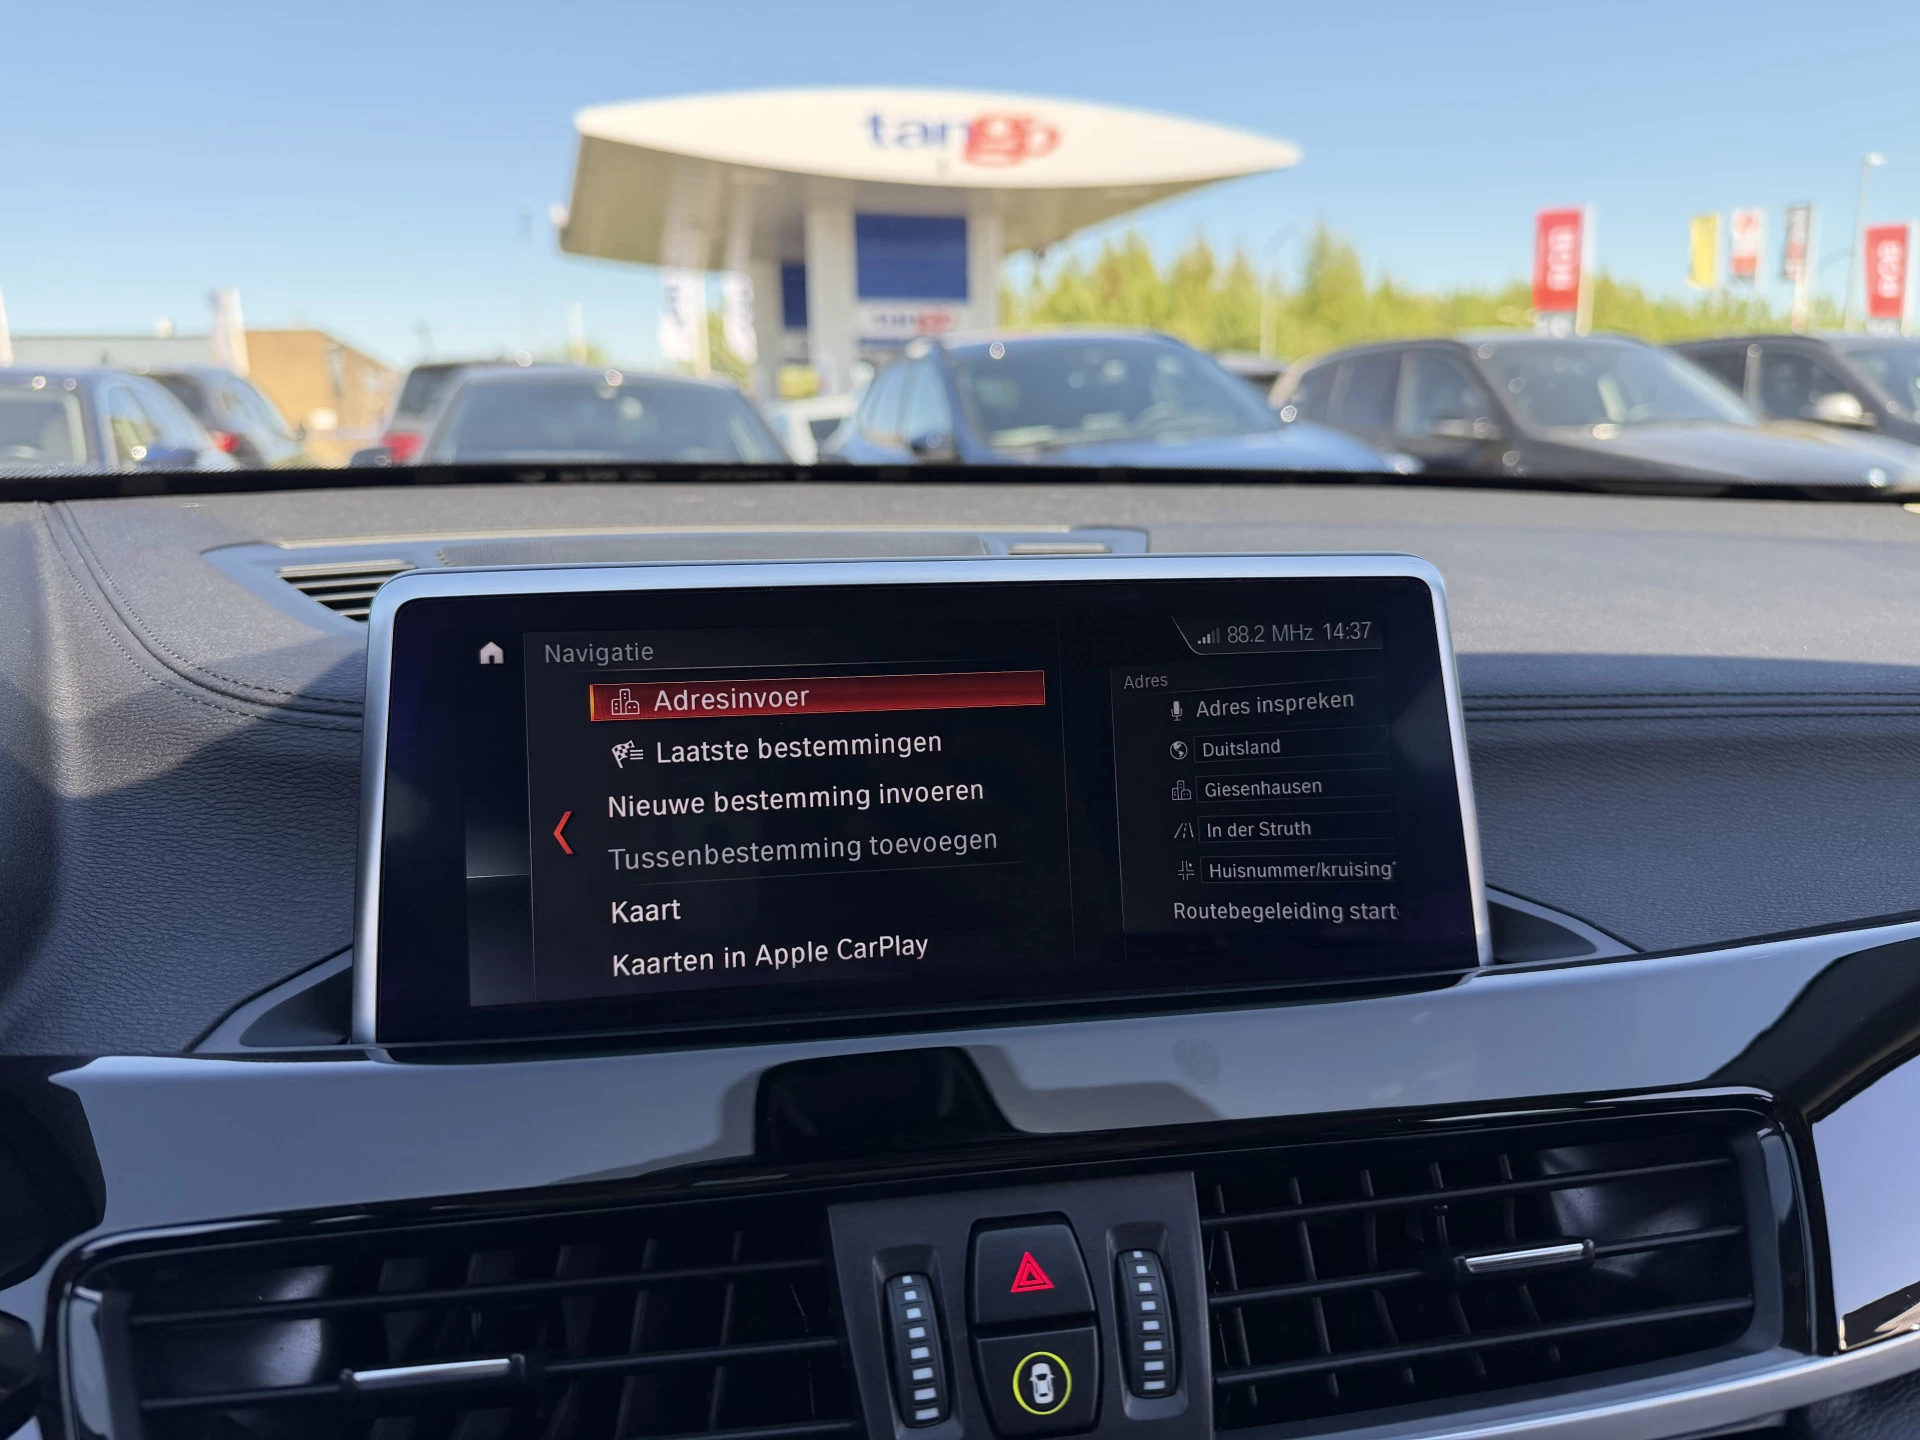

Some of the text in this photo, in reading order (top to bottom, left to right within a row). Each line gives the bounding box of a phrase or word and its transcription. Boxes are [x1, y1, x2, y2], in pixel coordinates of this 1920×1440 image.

[1227, 621, 1371, 643] 88.2 MHz 14:37
[545, 642, 654, 666] Navigatie
[1124, 674, 1168, 689] Adres
[654, 687, 809, 712] Adresinvoer
[1197, 692, 1354, 717] Adres inspreken
[656, 733, 942, 764] Laatste bestemmingen
[1203, 739, 1280, 757] Duitsland
[609, 781, 984, 818] Nieuwe bestemming invoeren
[1205, 778, 1322, 797] Giesenhausen
[1207, 820, 1311, 837] In der Struth
[609, 830, 998, 870] Tussenbestemming toevoegen
[612, 899, 681, 923] Kaart
[1174, 902, 1343, 923] Routebegeleiding
[613, 935, 928, 977] Kaarten in Apple CarPlay
